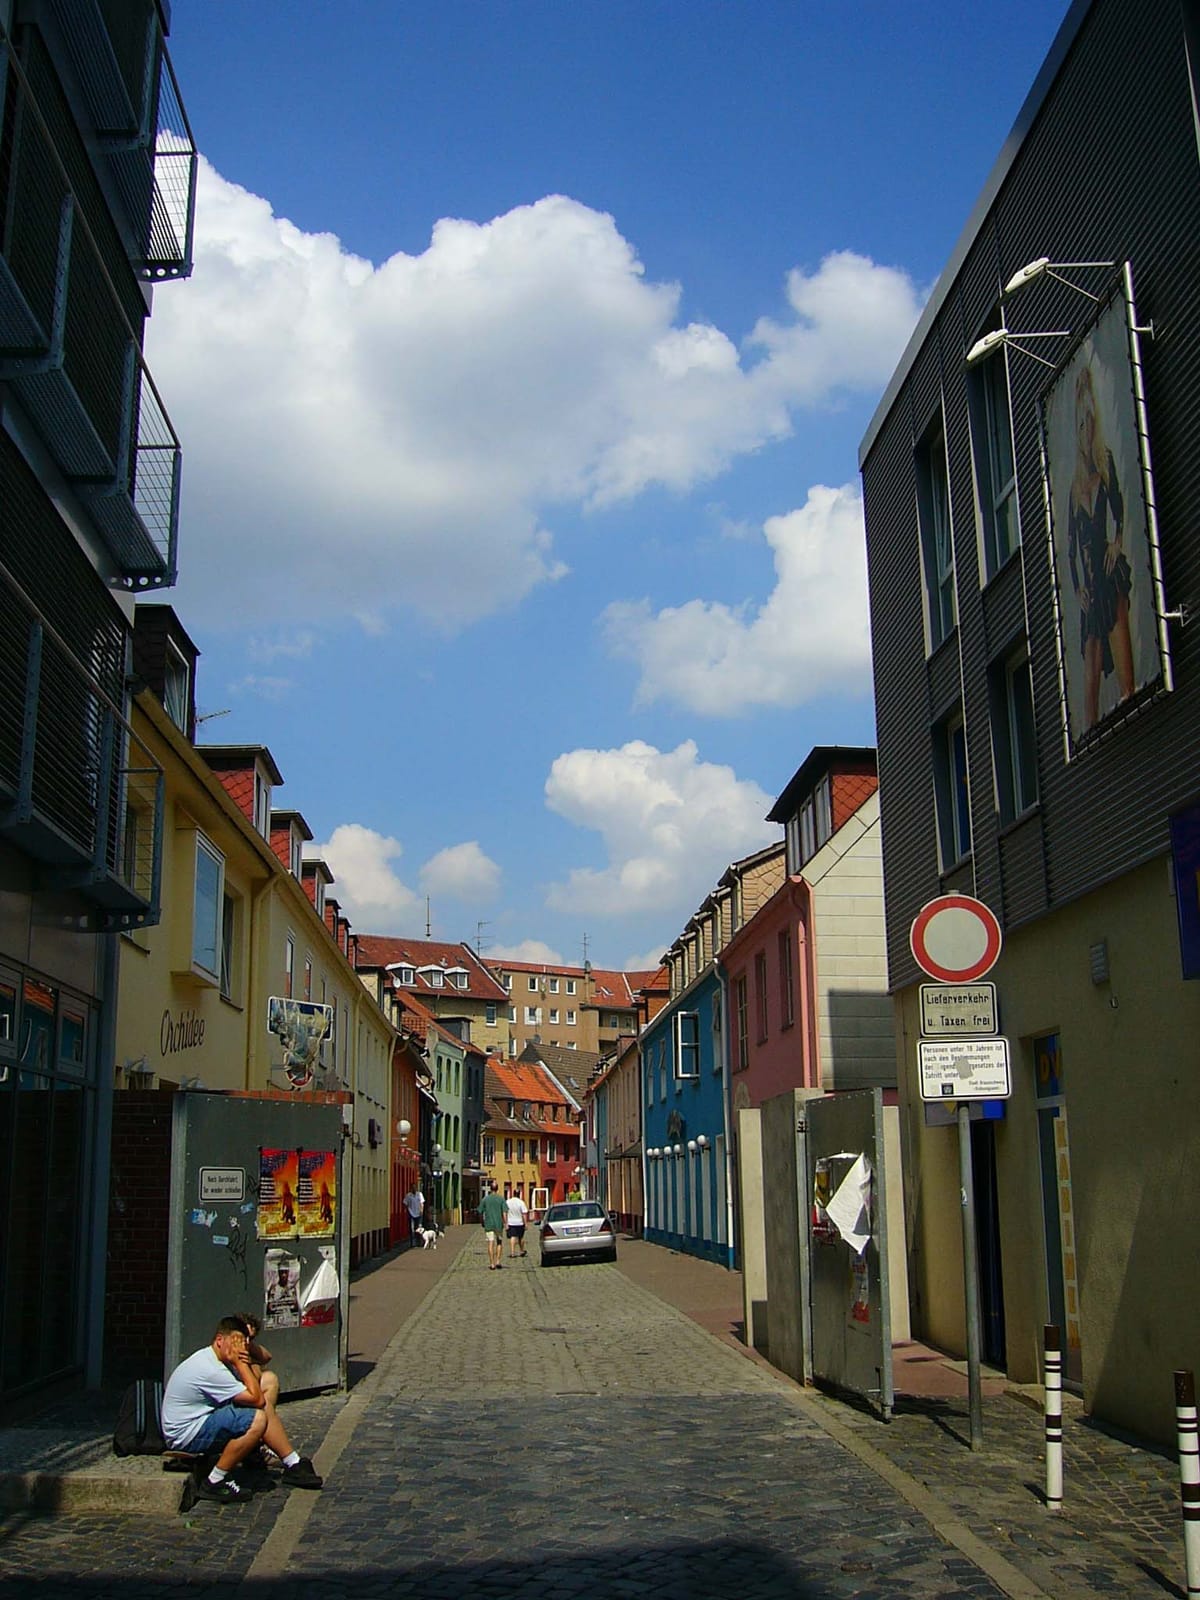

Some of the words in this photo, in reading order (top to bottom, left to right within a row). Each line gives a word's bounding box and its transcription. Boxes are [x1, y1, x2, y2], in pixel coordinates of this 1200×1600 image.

[926, 993, 989, 1004] Lieferverkehr
[940, 1015, 966, 1026] Taxen
[974, 1015, 990, 1025] frei
[160, 1009, 205, 1057] Orchidee
